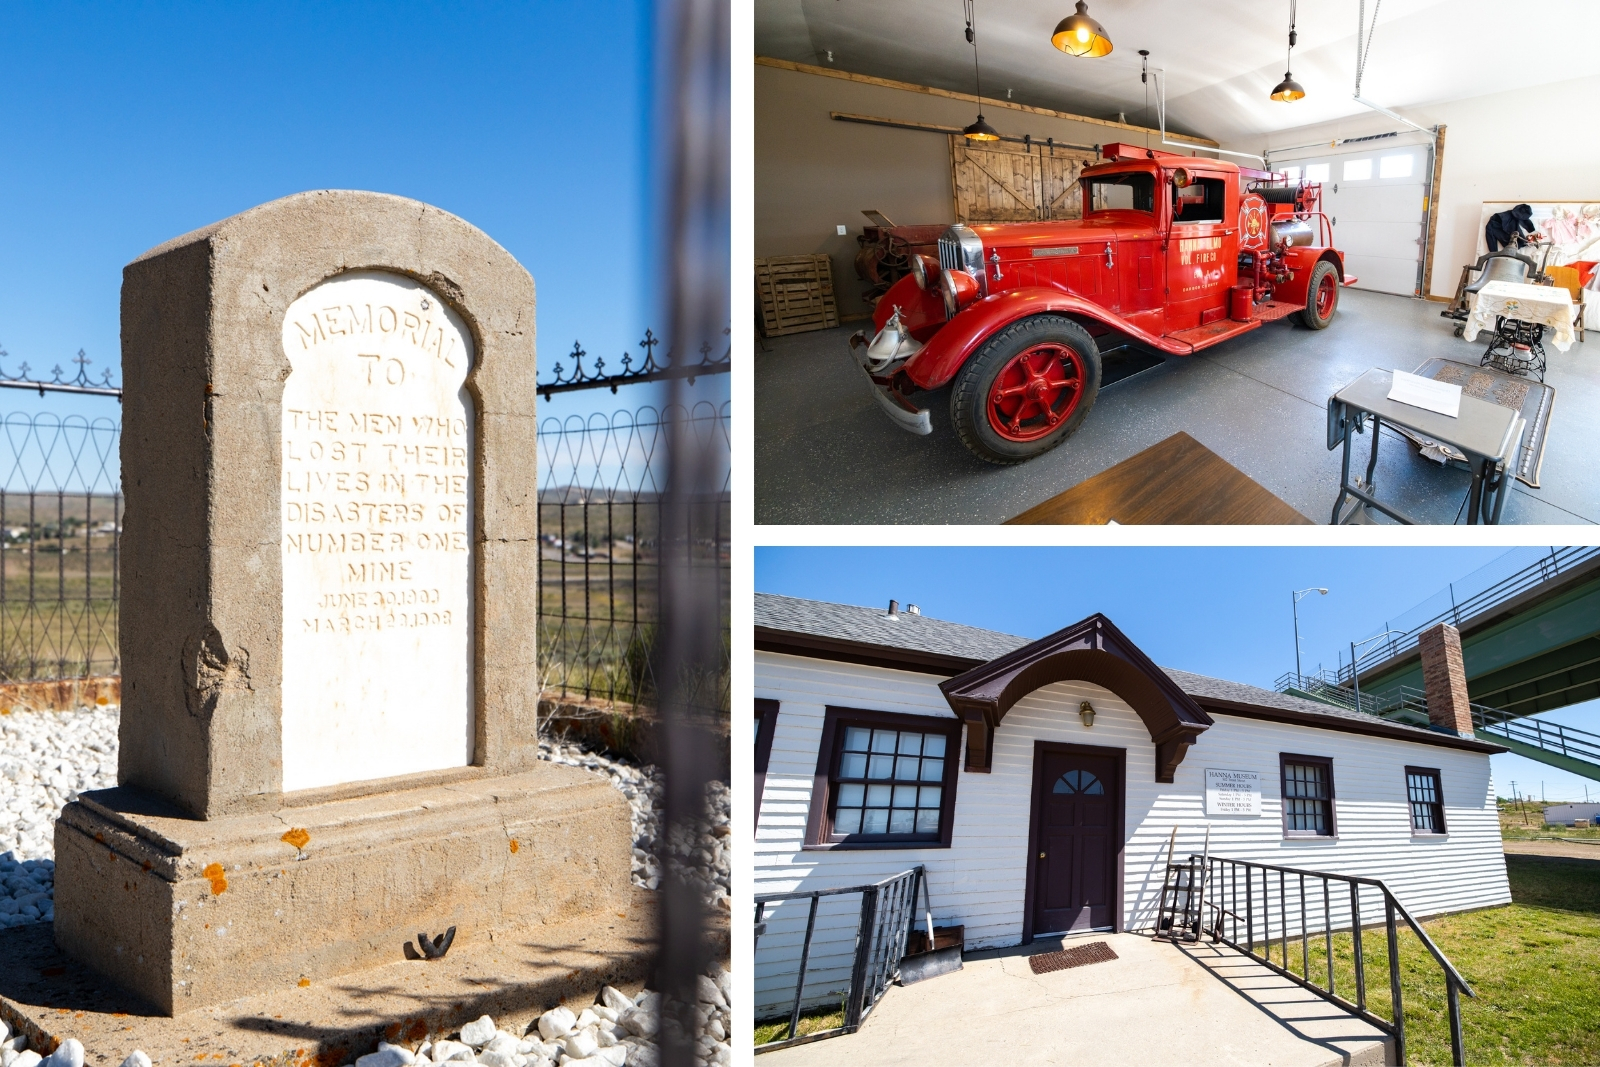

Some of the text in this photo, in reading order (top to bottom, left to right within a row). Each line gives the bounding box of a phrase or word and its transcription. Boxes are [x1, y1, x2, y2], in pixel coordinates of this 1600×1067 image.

[1196, 253, 1209, 263] FIRE
[293, 304, 457, 368] MEMORIAL
[357, 353, 406, 387] TO
[287, 409, 467, 438] THE MEN WHO
[287, 440, 466, 466] LOST THEIR
[287, 471, 466, 494] LIVES IN THE
[286, 501, 466, 524] DISASTERS OF
[287, 532, 466, 554] NUMBER ONE
[347, 561, 413, 583] MINE
[317, 591, 368, 609] JUNE
[302, 614, 381, 634] MARCH
